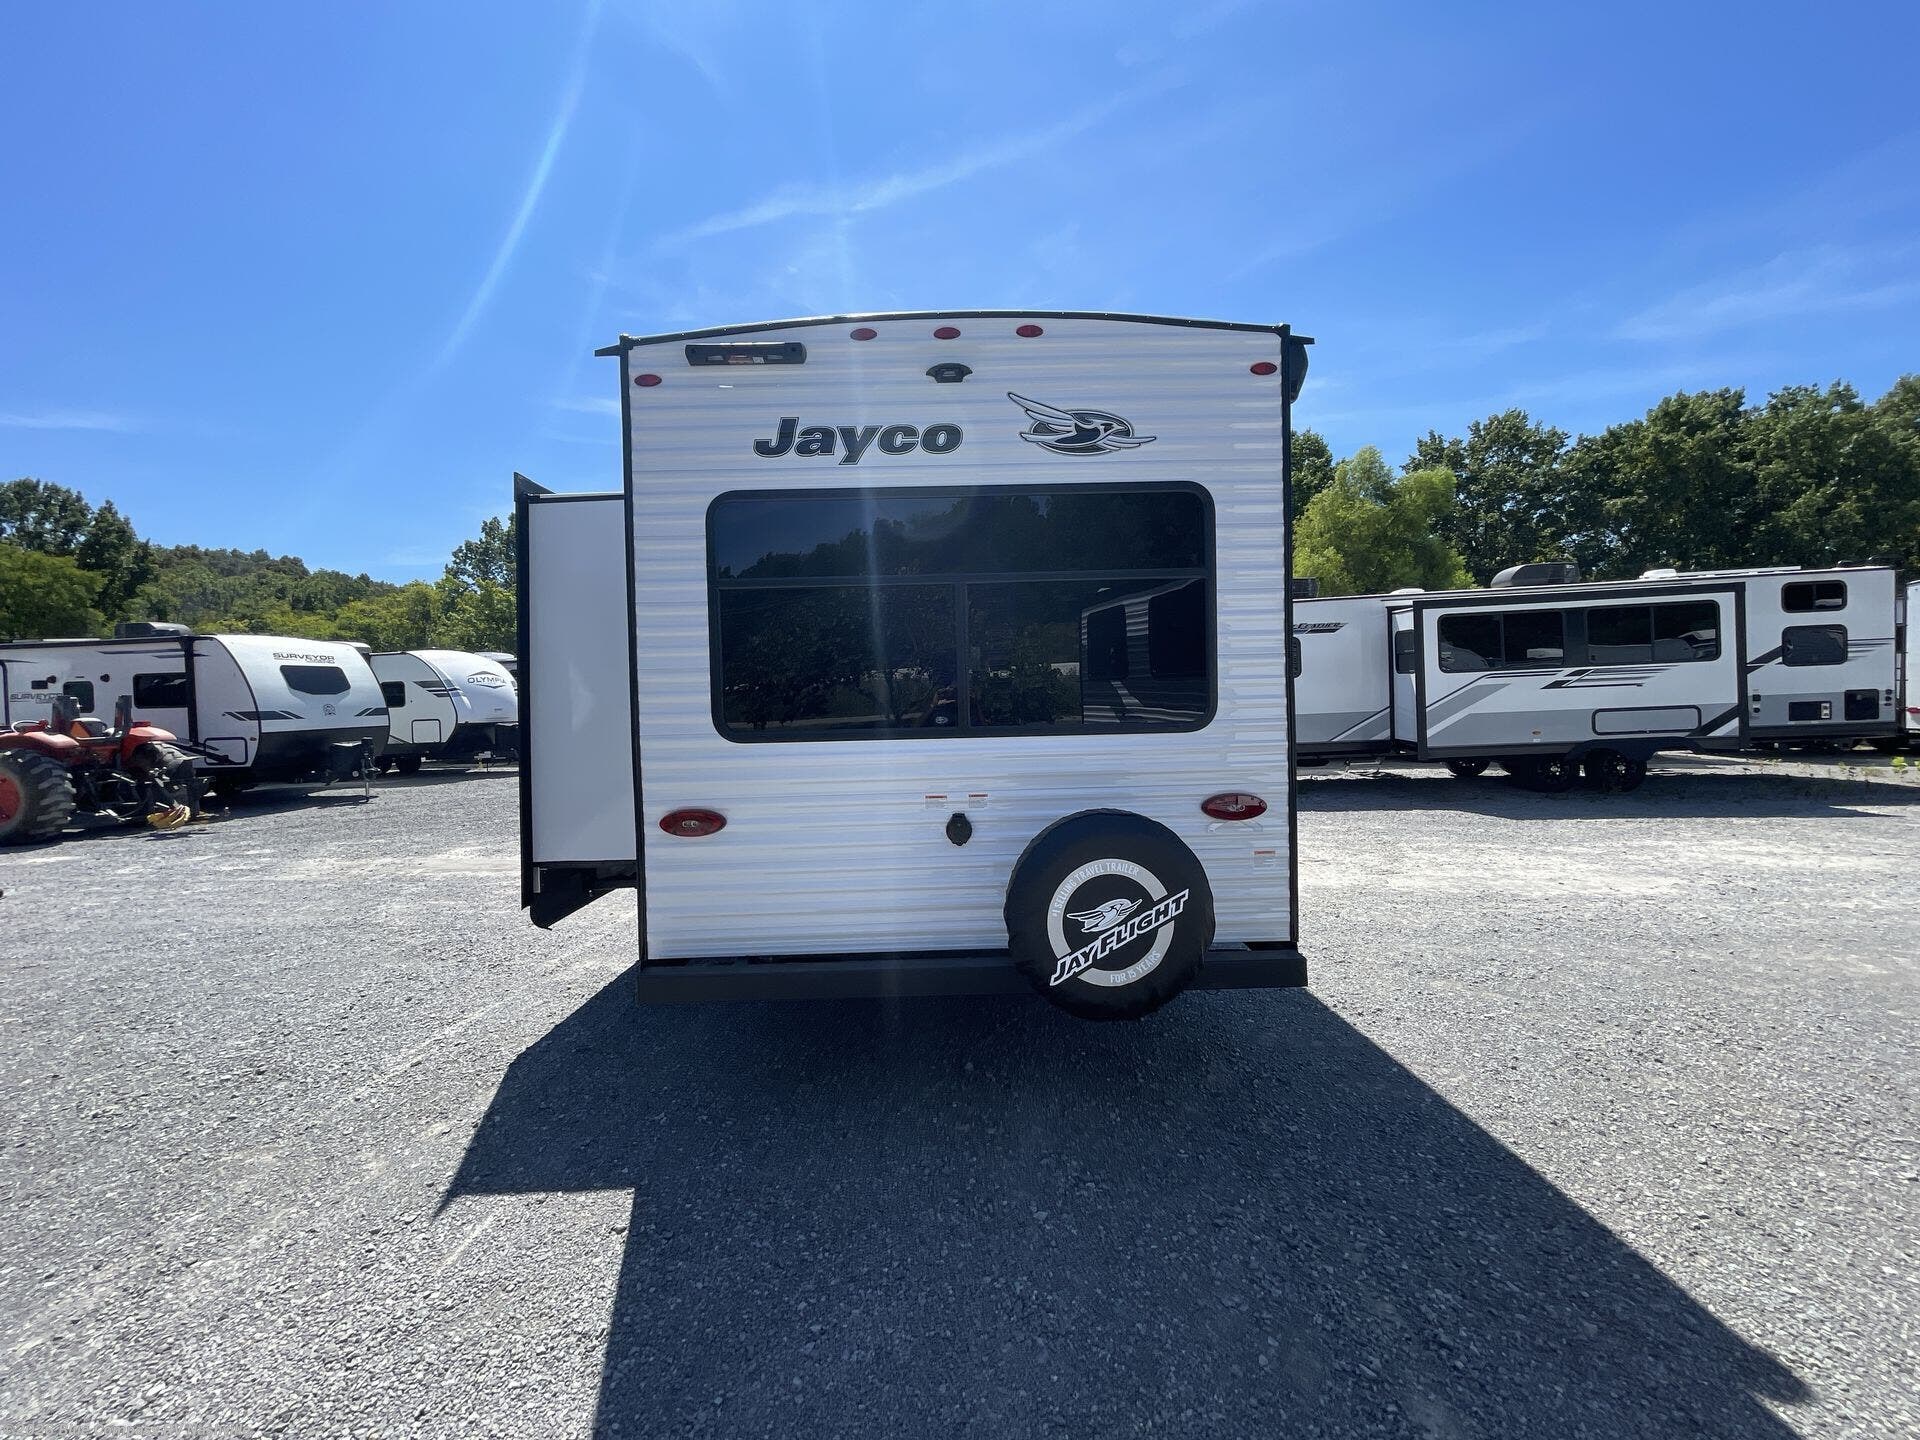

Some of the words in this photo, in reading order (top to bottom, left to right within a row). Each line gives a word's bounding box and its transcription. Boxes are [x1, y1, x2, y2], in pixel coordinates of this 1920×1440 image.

[753, 416, 964, 465] Jayco
[273, 652, 335, 661] SURVEYOR
[1054, 879, 1077, 909] SELLING
[1073, 863, 1105, 881] TRAVEL
[1105, 862, 1140, 876] TRAILER
[1049, 940, 1099, 986] JAY
[1097, 888, 1189, 960] FLIGHT
[1110, 973, 1127, 984] FOR
[1127, 969, 1137, 979] 15
[1136, 950, 1161, 974] YEARS
